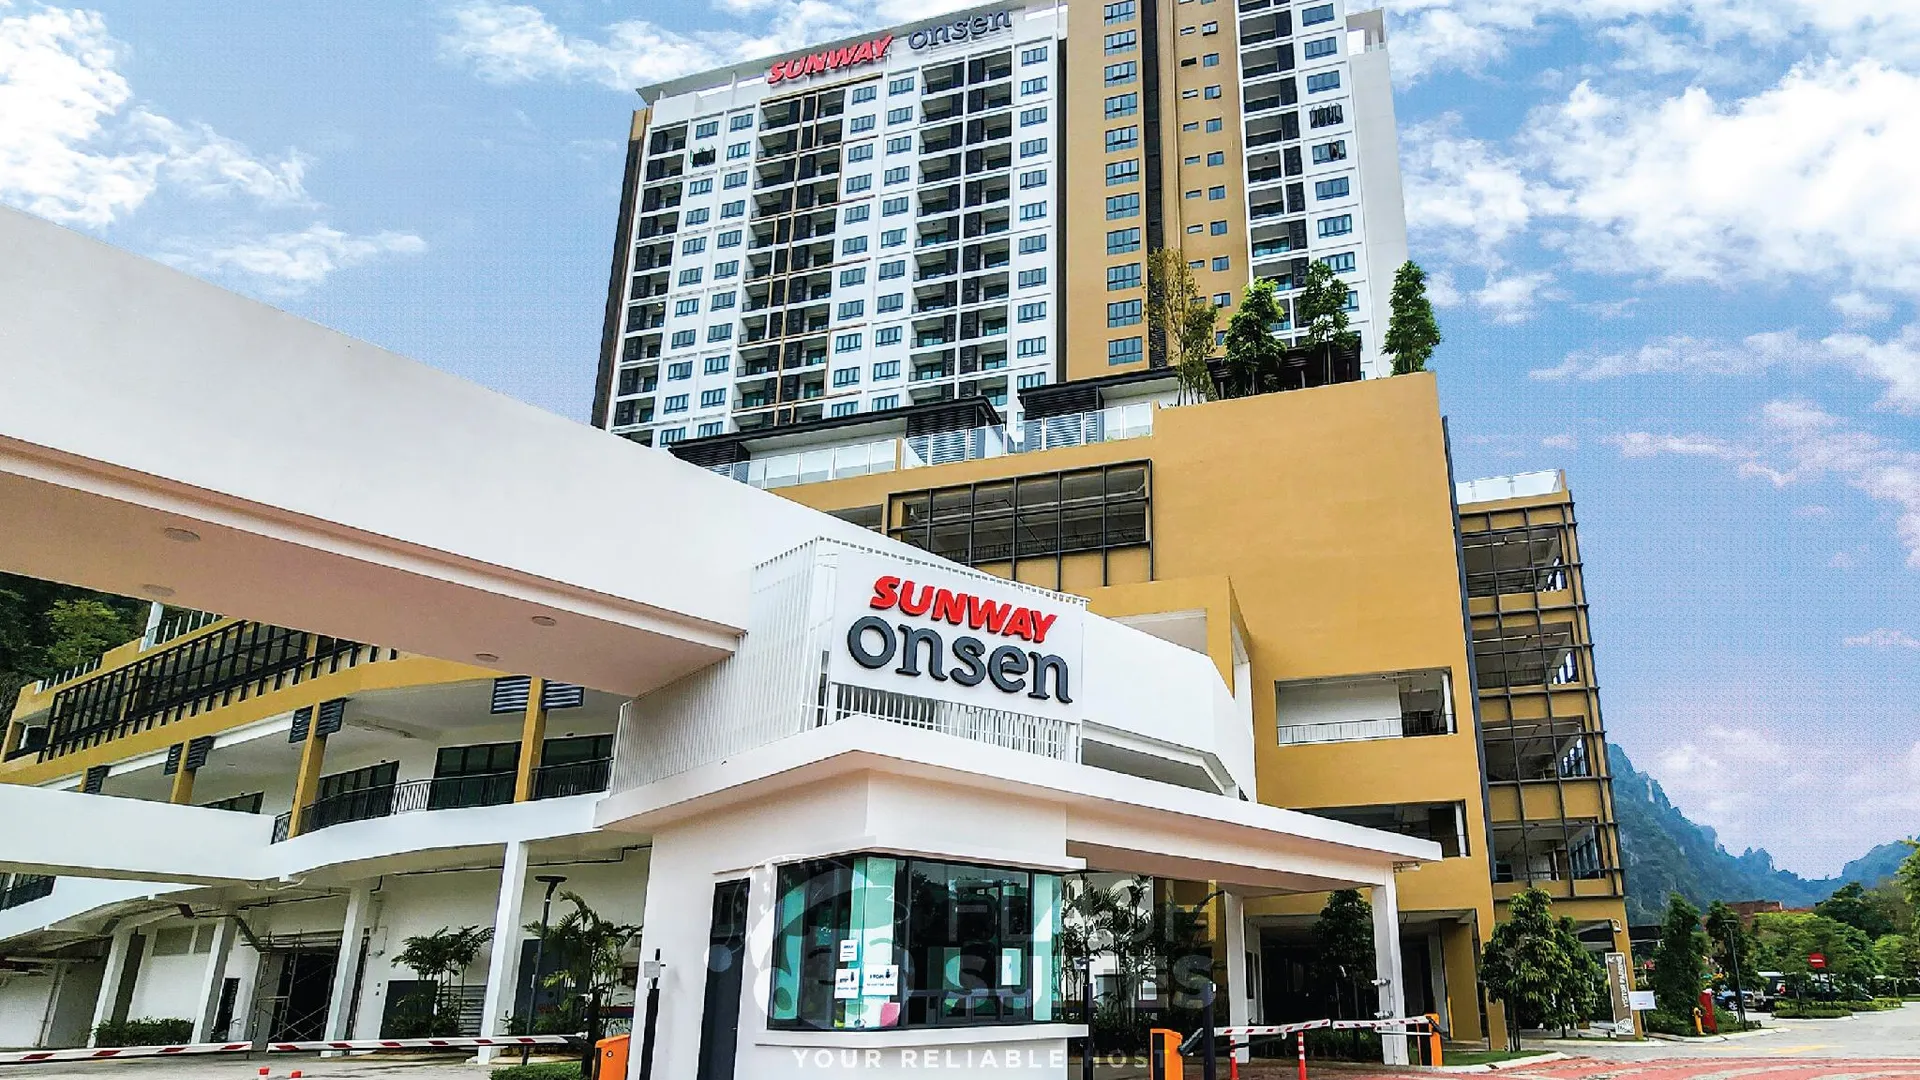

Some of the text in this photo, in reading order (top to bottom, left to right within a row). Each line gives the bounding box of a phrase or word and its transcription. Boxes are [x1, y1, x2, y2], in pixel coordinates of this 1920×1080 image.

[767, 8, 1012, 84] SUNWAY onsen
[869, 574, 1056, 643] SUNWAY
[847, 615, 1074, 704] onsen
[1620, 985, 1629, 1008] VISITOR
